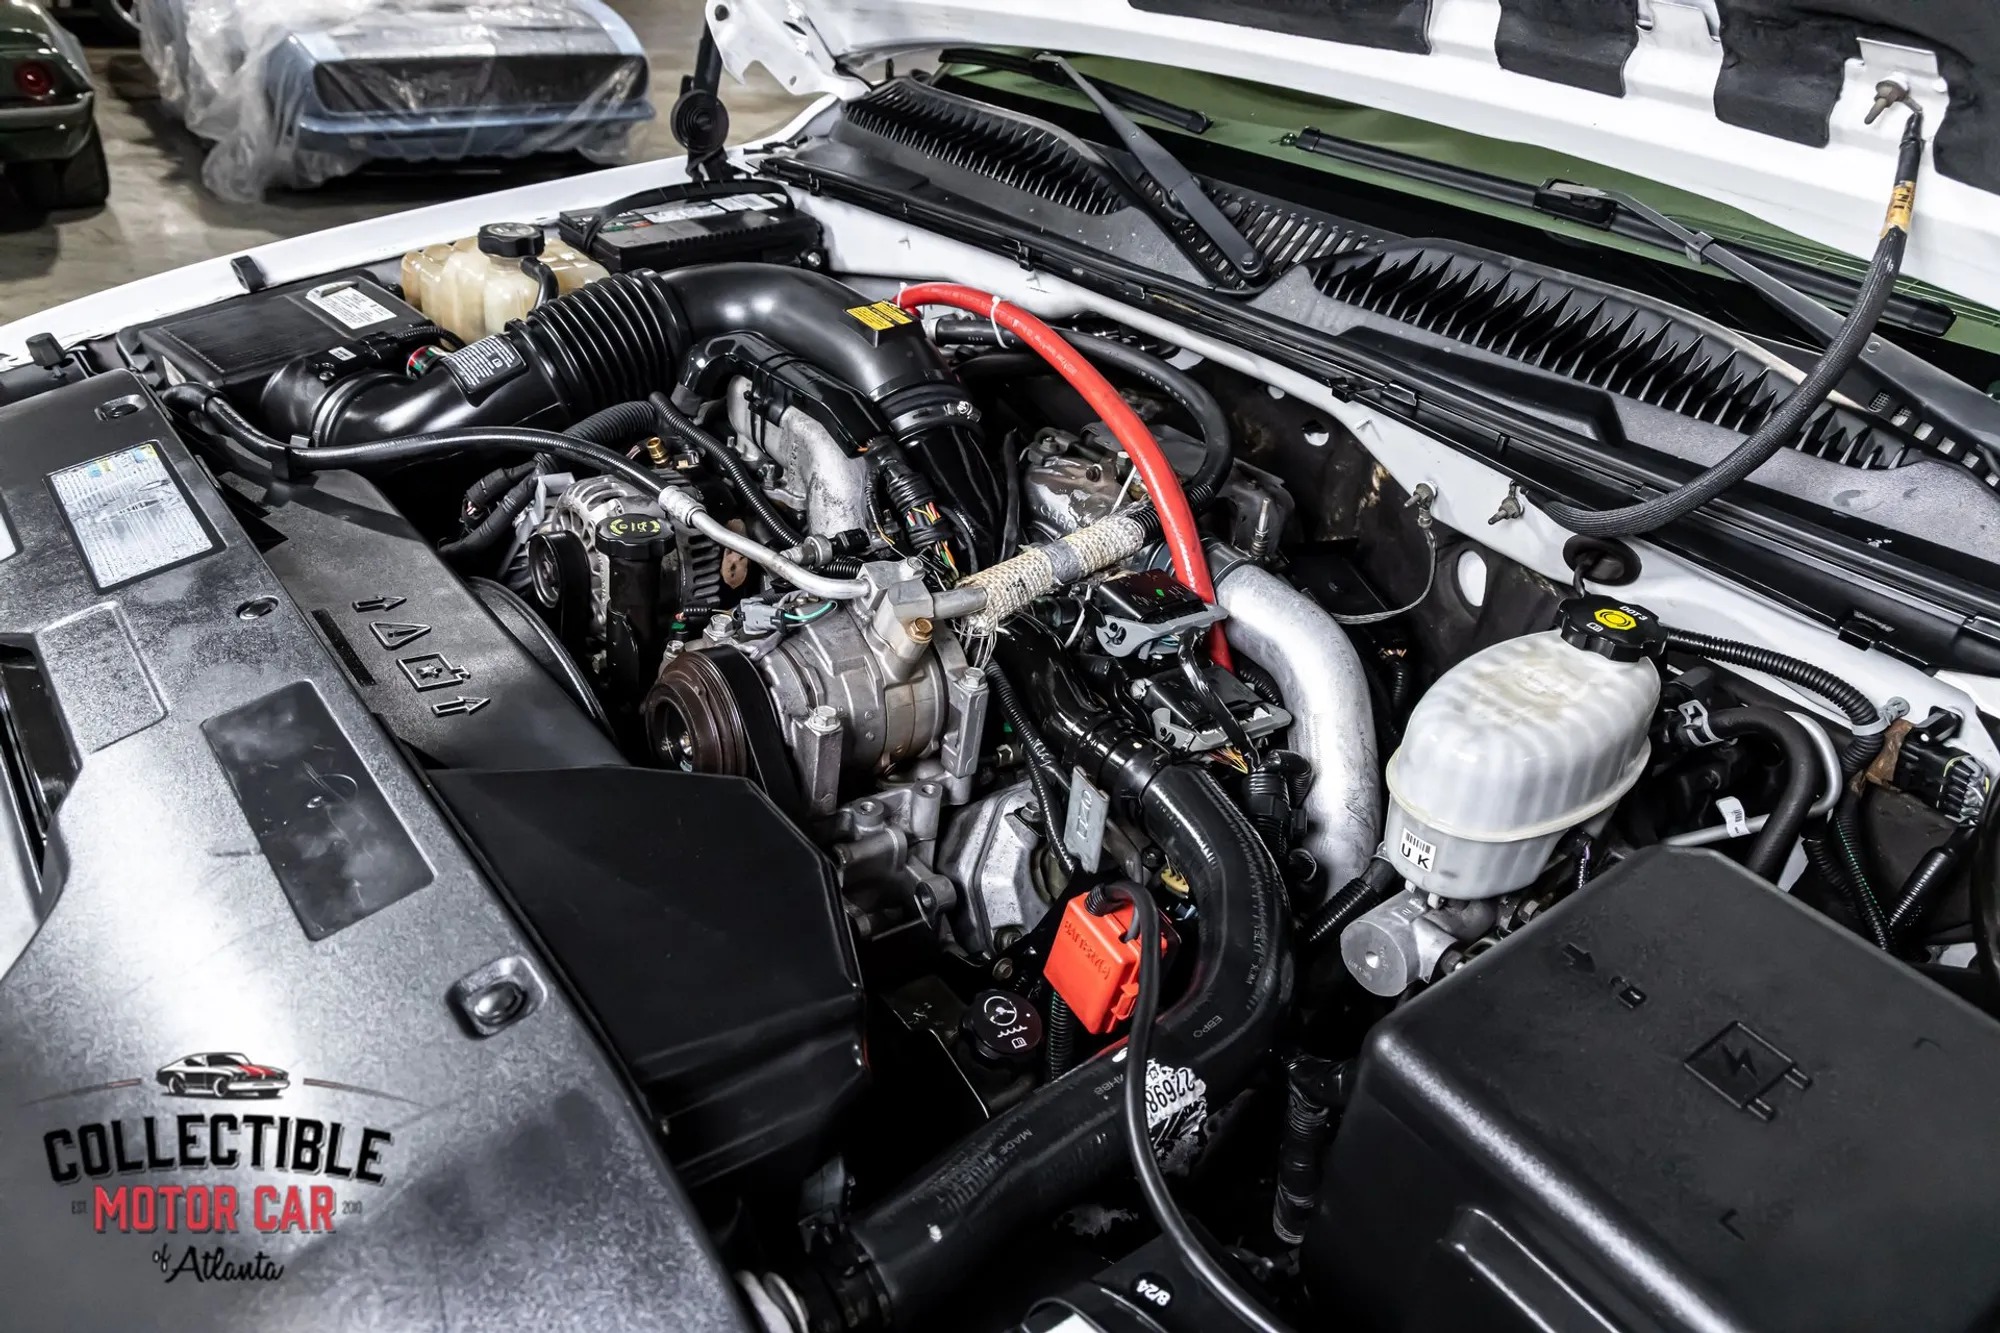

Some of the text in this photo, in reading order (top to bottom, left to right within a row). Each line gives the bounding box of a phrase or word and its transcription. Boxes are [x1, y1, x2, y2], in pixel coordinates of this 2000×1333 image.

[1619, 605, 1641, 616] DOT
[1000, 1129, 1033, 1154] MADE
[1136, 1279, 1171, 1306] 8/24
